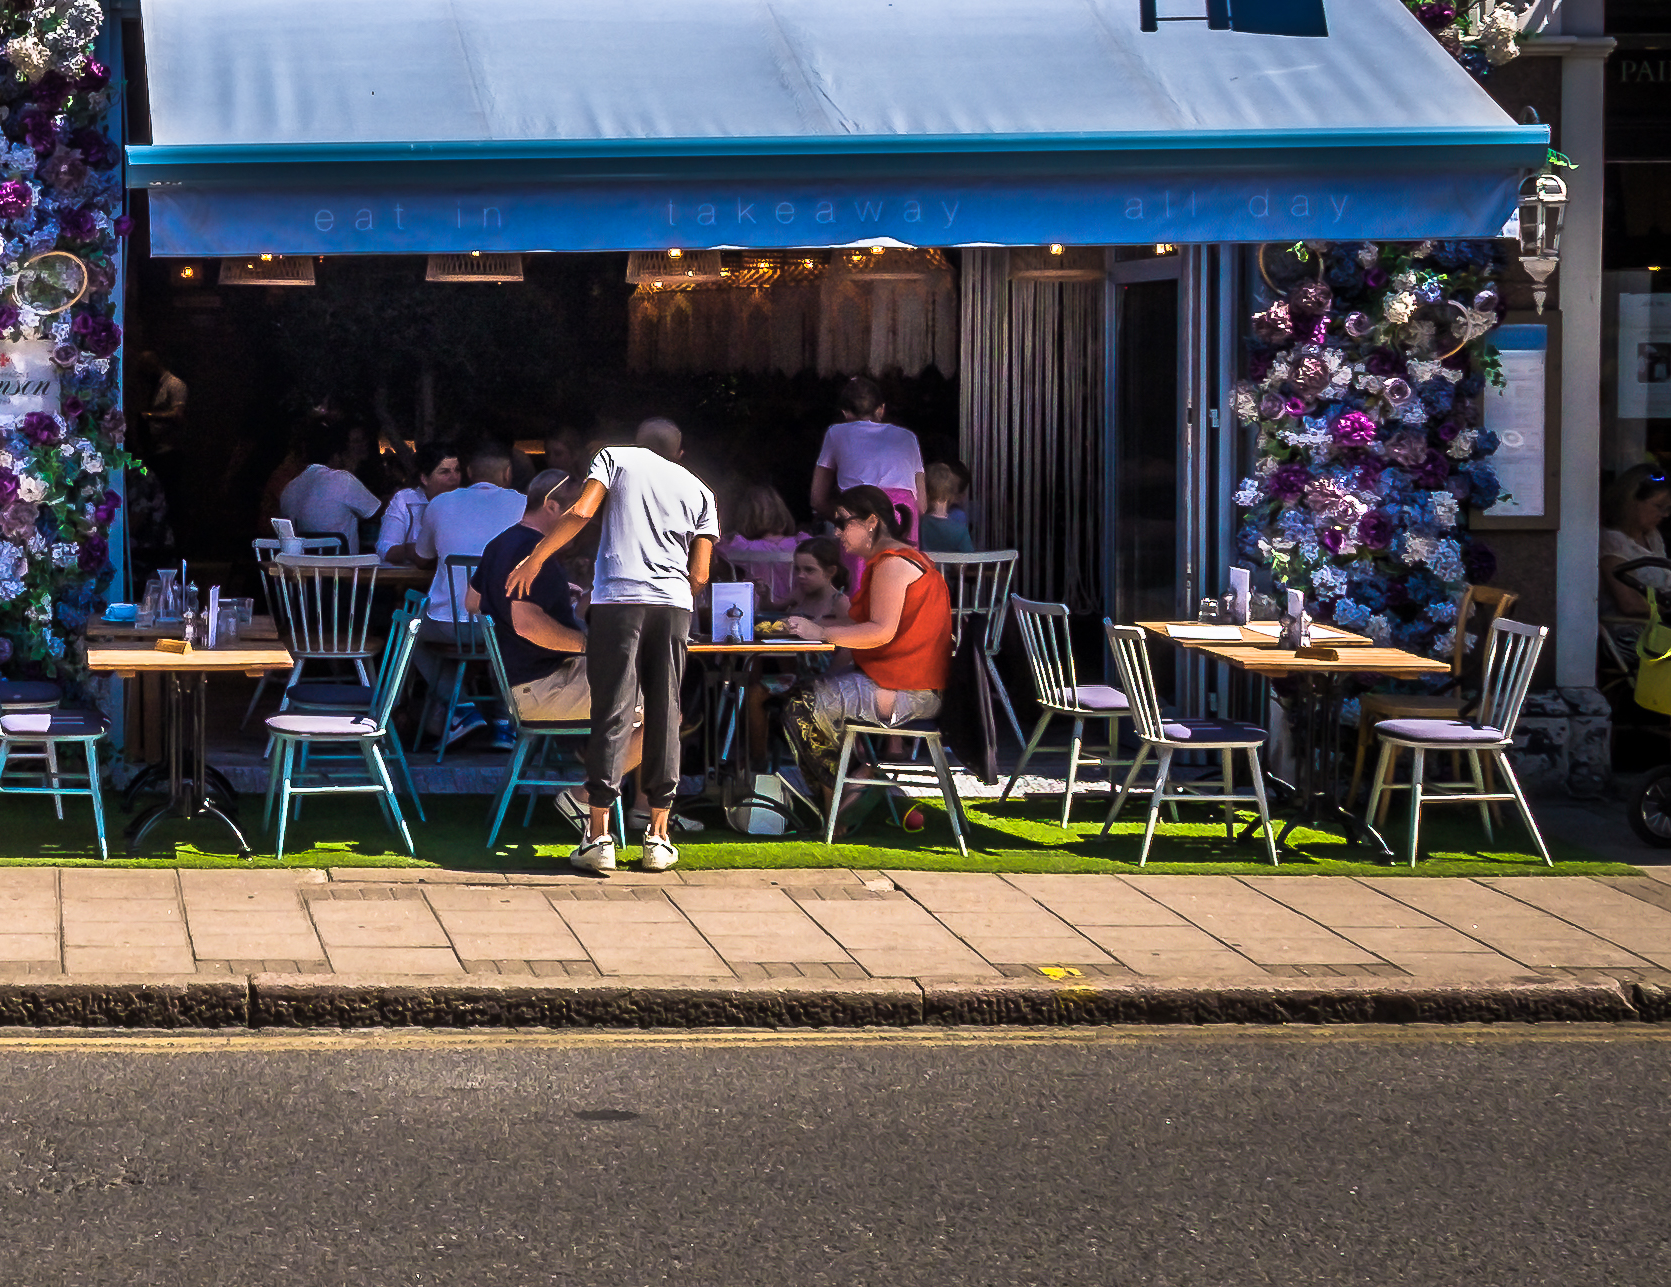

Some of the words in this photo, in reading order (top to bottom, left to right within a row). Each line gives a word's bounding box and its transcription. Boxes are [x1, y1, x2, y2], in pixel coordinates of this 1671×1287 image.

[1620, 60, 1671, 82] PAI
[314, 202, 405, 232] eat
[456, 200, 502, 229] in
[667, 197, 960, 229] takeaway
[1124, 190, 1196, 220] all
[1248, 188, 1349, 223] day
